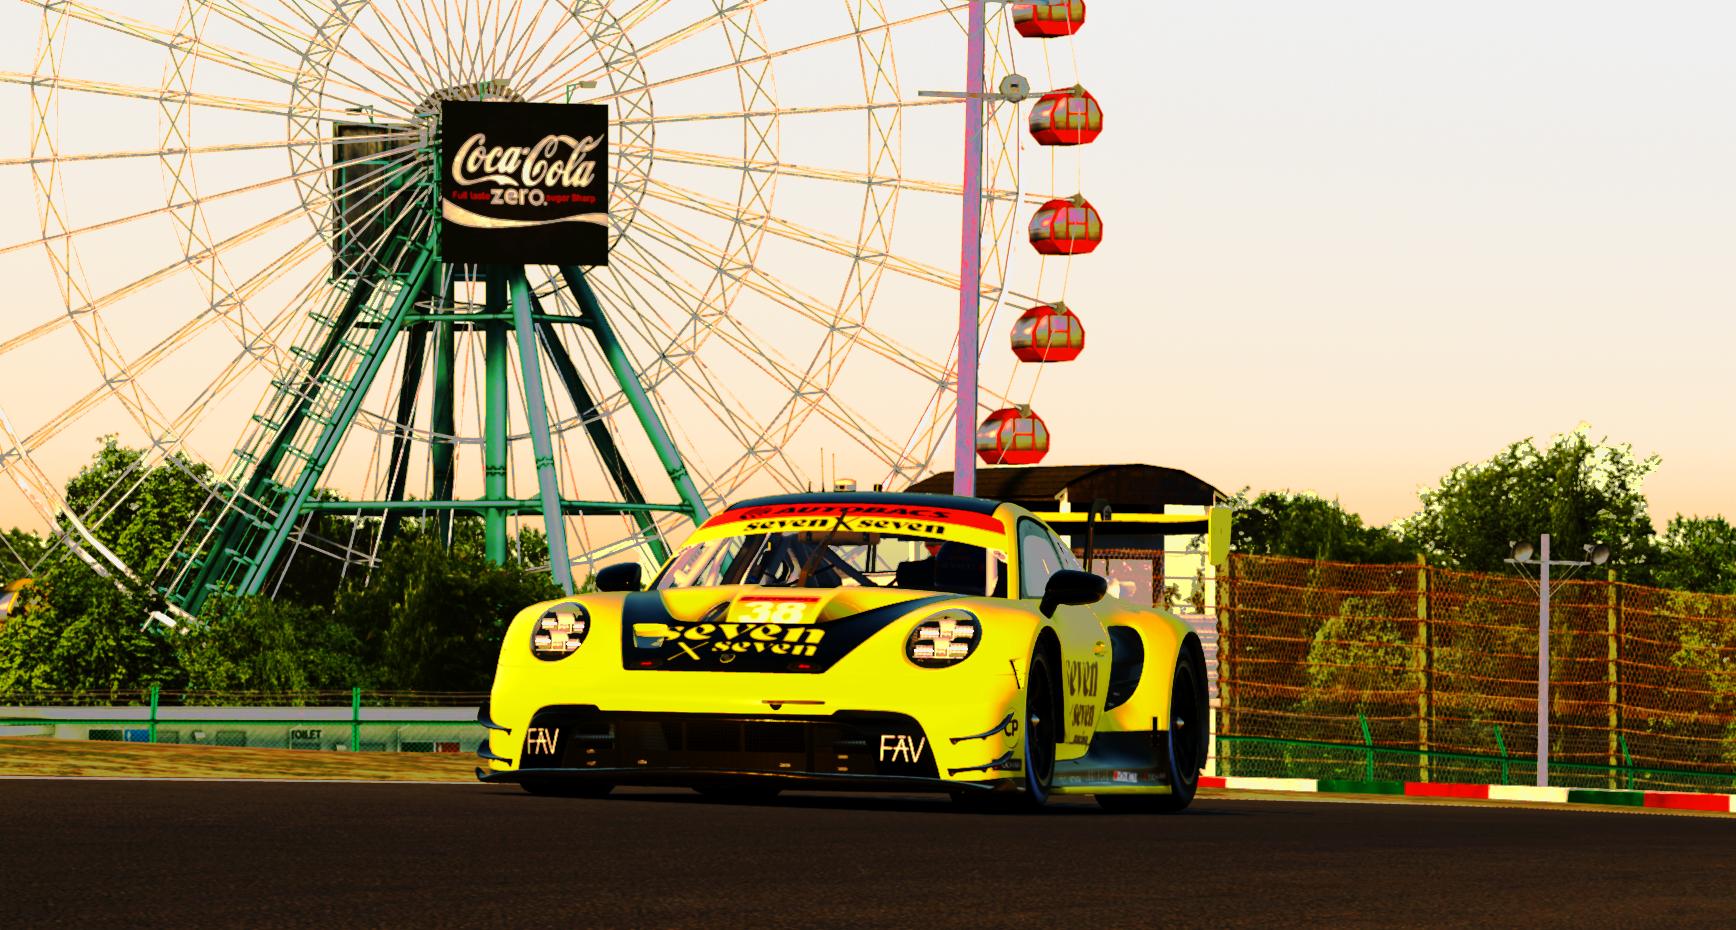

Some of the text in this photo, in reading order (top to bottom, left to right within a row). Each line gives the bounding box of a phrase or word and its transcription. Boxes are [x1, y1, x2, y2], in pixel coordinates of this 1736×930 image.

[452, 132, 605, 187] Coca-Cola
[772, 506, 950, 519] AUTOBACS
[743, 518, 828, 532] seven
[856, 519, 946, 535] seven
[738, 601, 806, 624] 38
[663, 623, 826, 645] seven
[712, 641, 817, 657] seven
[527, 727, 560, 755] FAV
[880, 734, 926, 763] FAV
